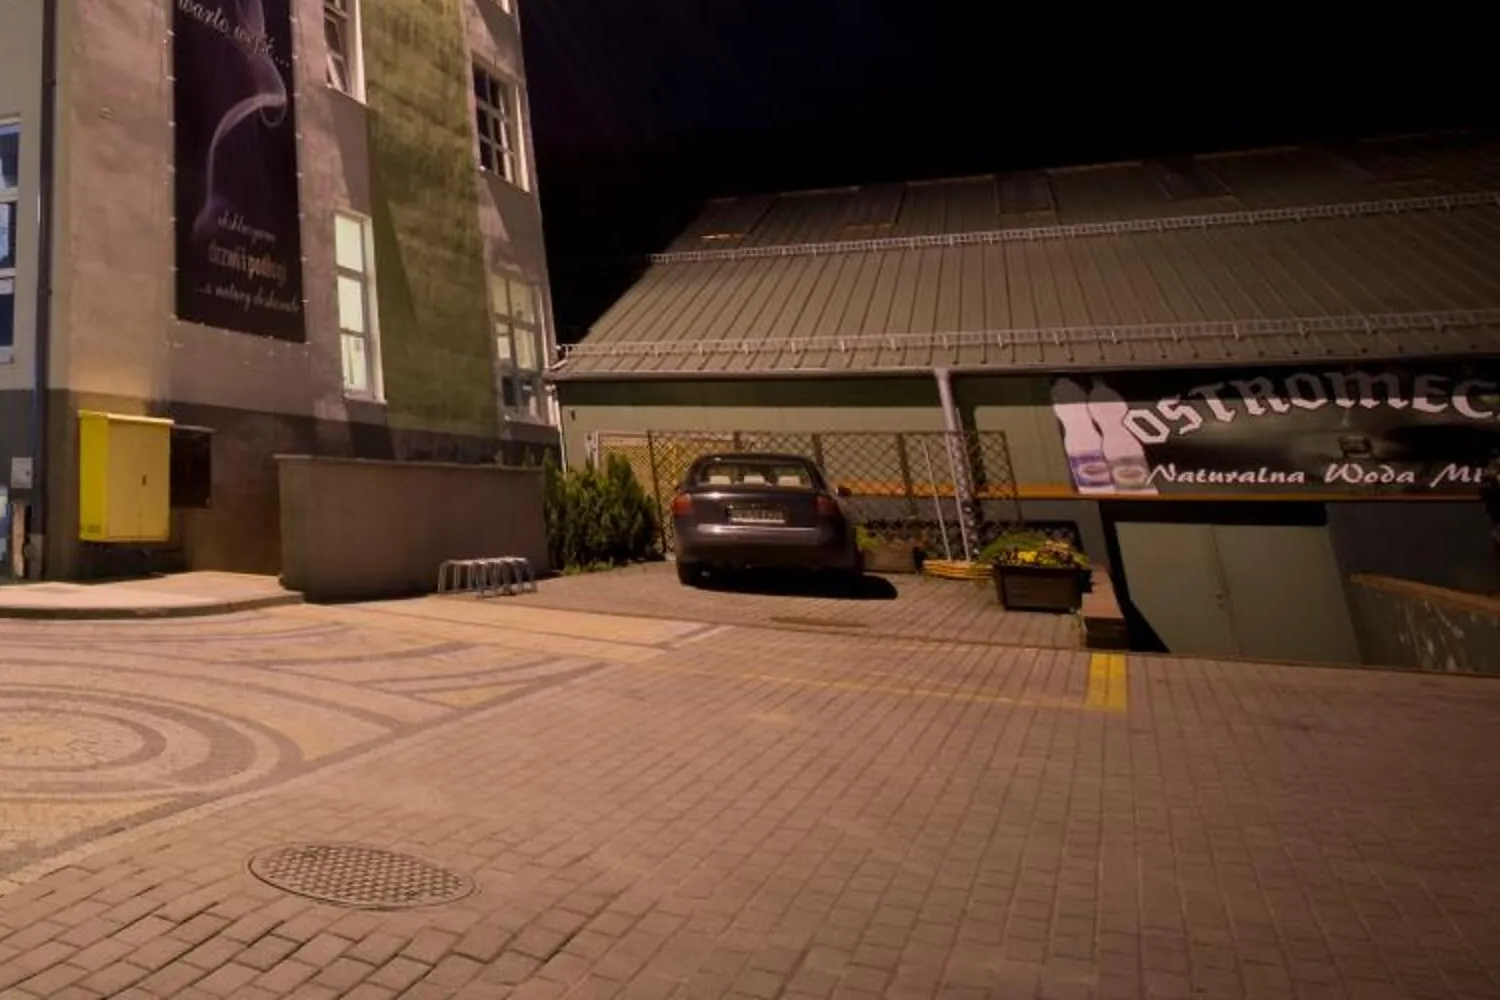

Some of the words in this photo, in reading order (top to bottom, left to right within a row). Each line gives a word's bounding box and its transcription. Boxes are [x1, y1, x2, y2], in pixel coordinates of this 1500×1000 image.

[1122, 371, 1500, 444] OSTROMEC
[1145, 463, 1306, 485] Naturalna
[1324, 463, 1416, 485] Woda
[1429, 463, 1484, 488] Mi
